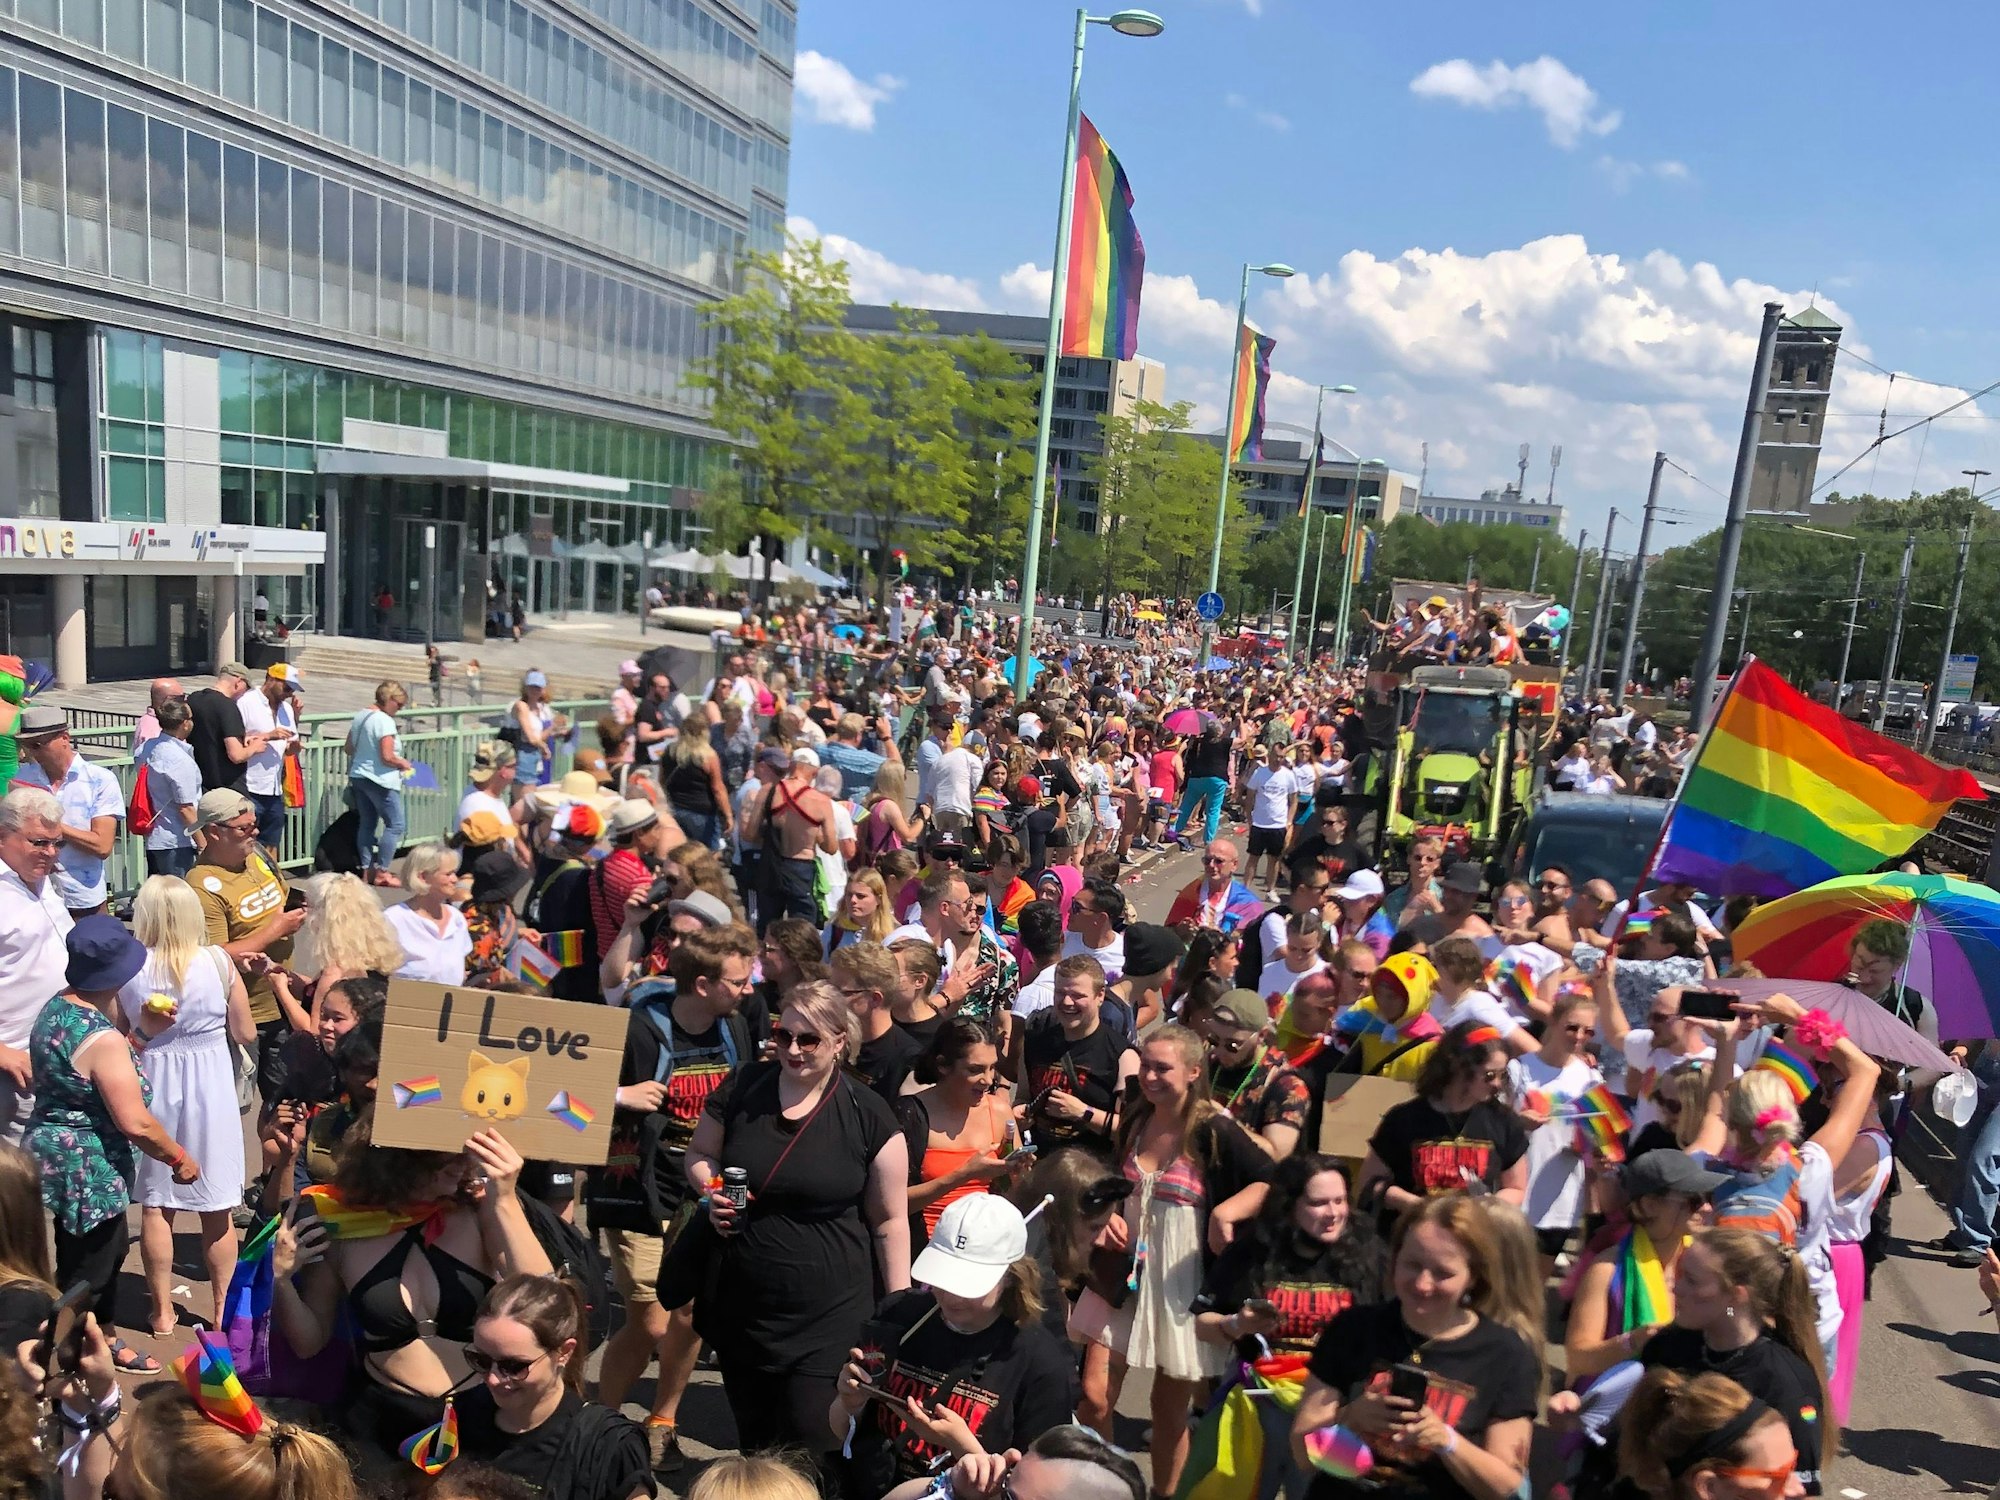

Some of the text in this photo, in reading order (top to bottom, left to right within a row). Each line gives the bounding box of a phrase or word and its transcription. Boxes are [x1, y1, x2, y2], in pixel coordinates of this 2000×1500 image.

[240, 881, 281, 918] GS
[437, 992, 590, 1060] I Love
[955, 1235, 967, 1250] E
